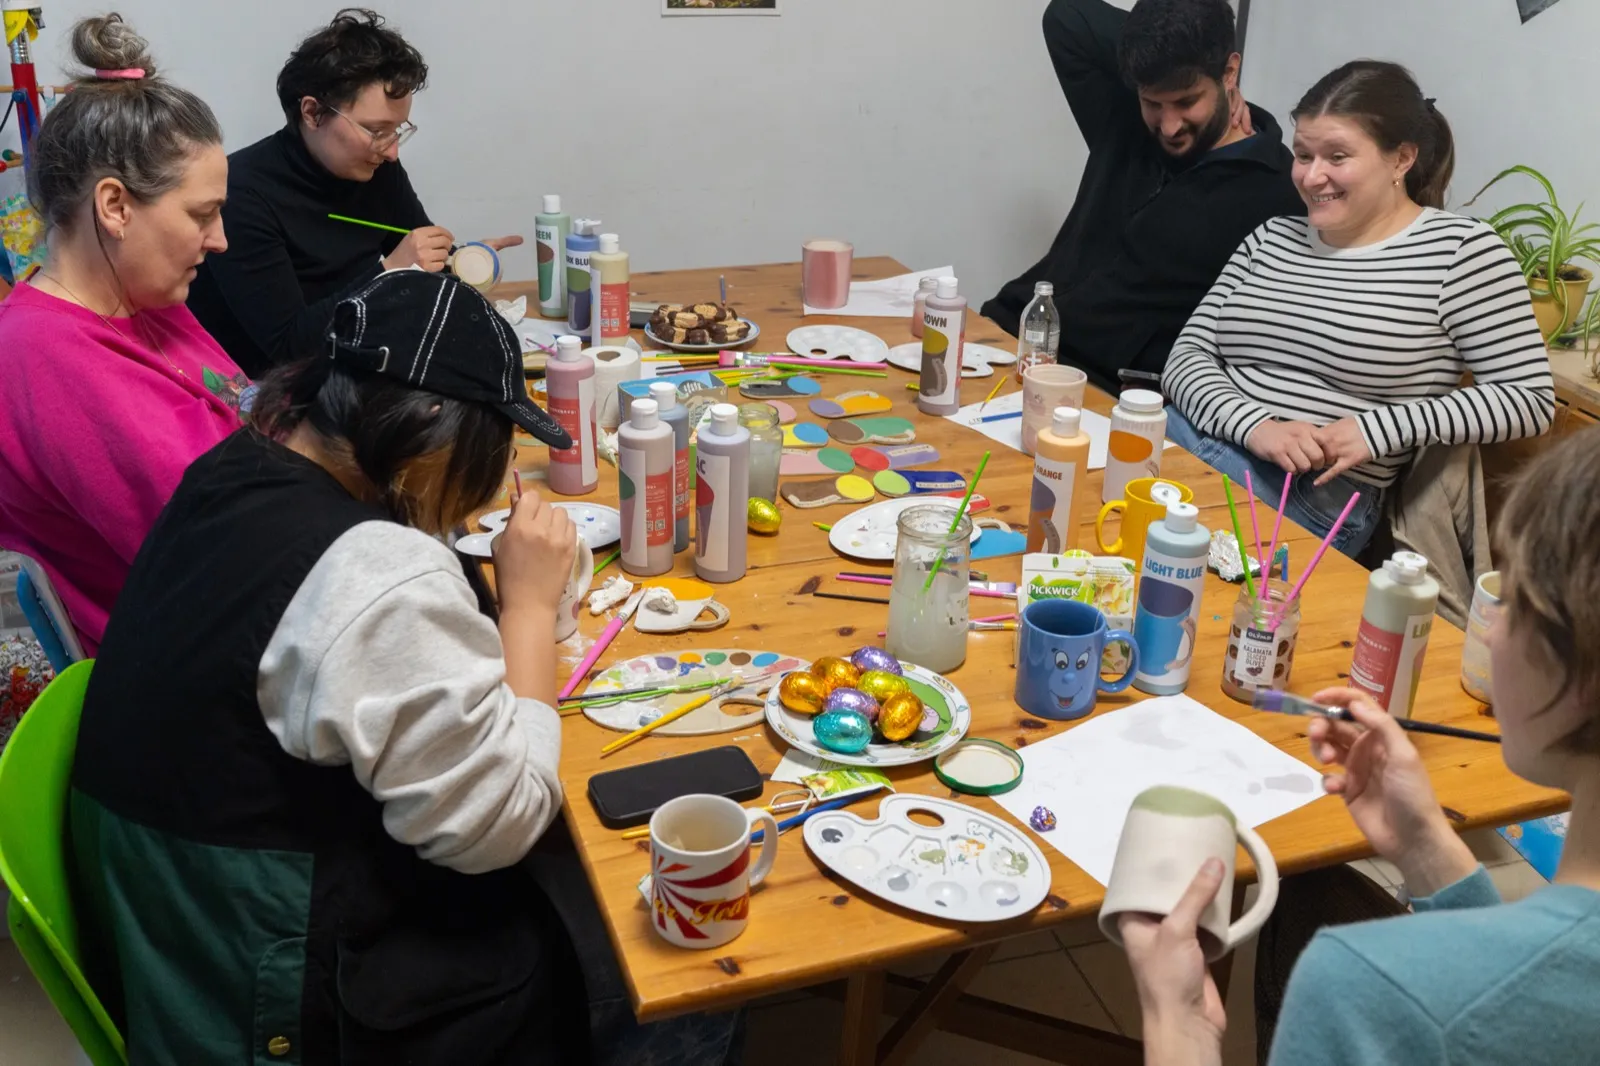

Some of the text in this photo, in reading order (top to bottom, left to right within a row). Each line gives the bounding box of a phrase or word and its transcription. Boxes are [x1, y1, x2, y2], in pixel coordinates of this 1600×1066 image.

[1145, 556, 1174, 578] LIGHT
[1176, 566, 1203, 580] BLUE
[1027, 583, 1079, 597] PICKWICK
[1243, 644, 1272, 656] KALAMATA
[1246, 652, 1267, 662] SLICED
[1245, 659, 1266, 670] OLIVES
